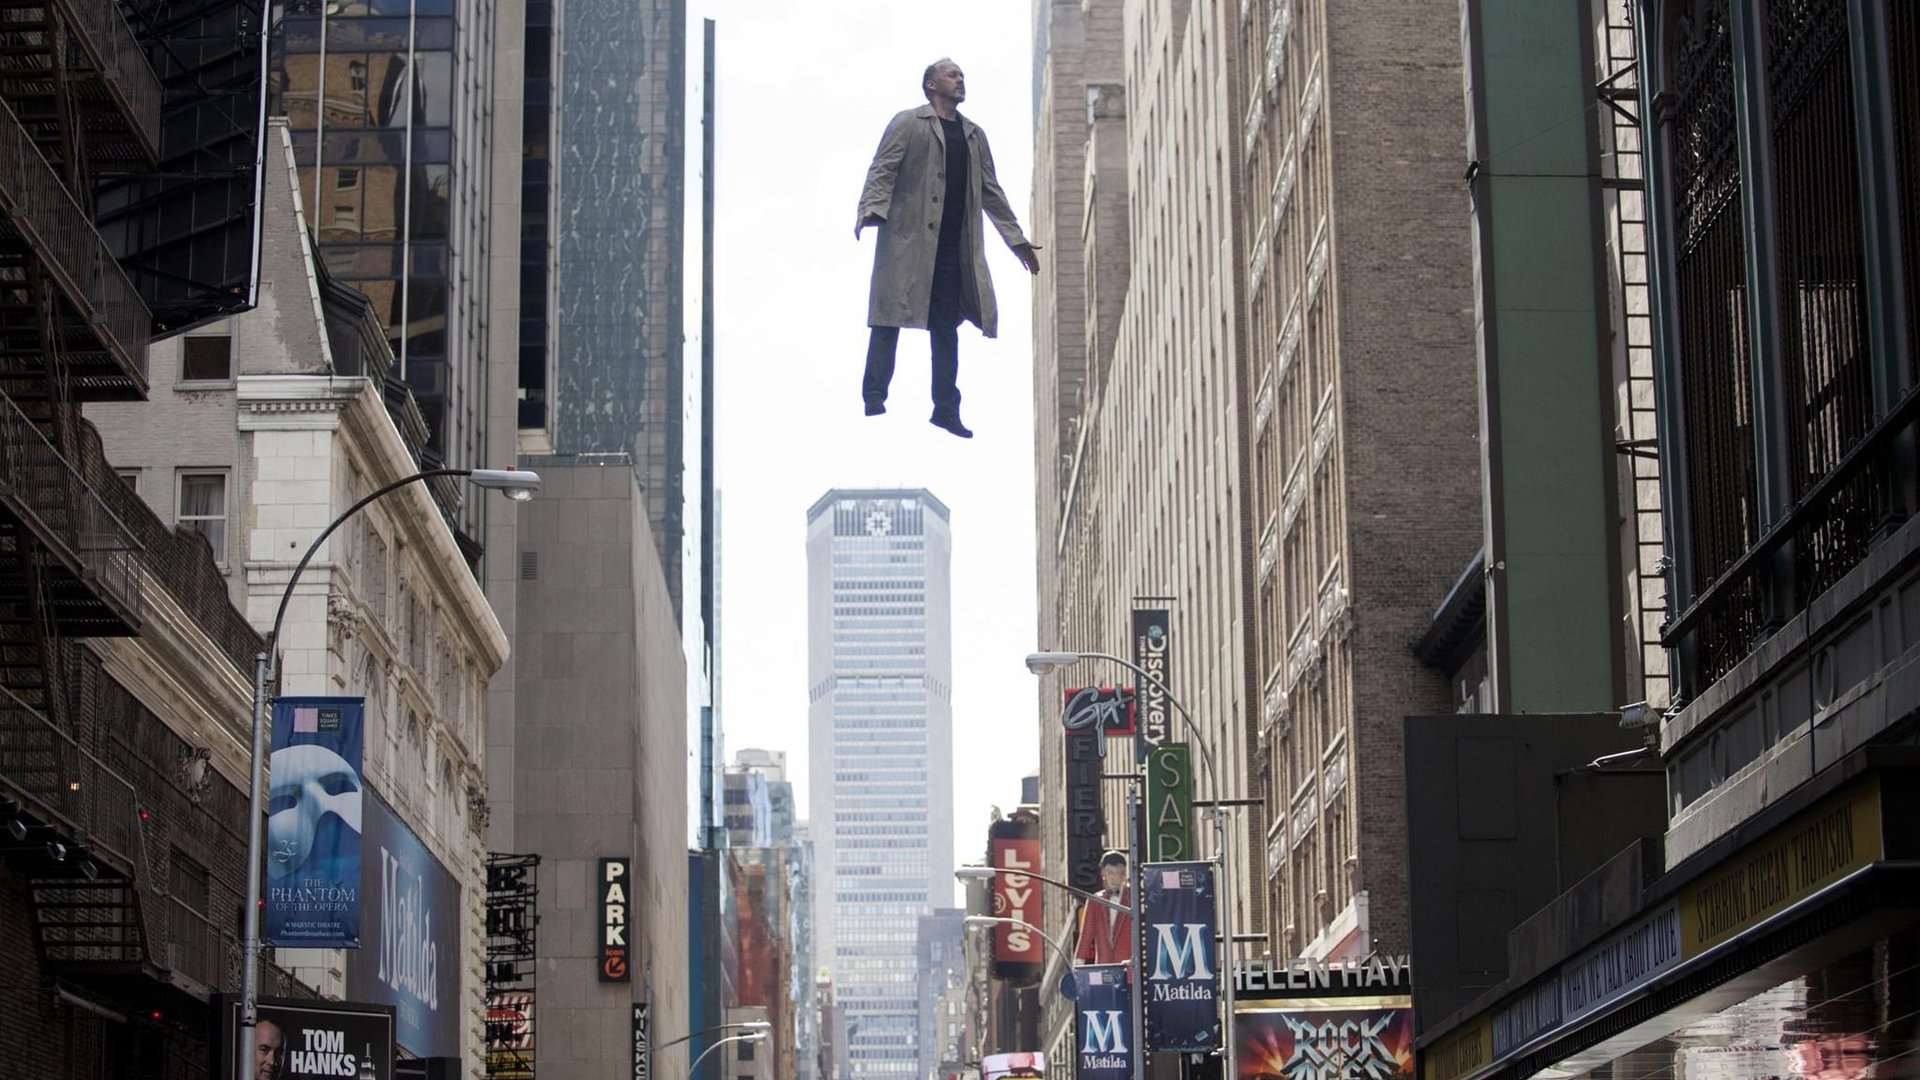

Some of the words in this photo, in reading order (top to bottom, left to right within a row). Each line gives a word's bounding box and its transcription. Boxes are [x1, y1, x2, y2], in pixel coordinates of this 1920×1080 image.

[304, 879, 323, 887] THE
[1697, 870, 1747, 943] STARRING
[1748, 841, 1789, 917] RIGGAN
[1791, 804, 1854, 891] THOMSON
[271, 888, 355, 902] PHANTOM
[275, 903, 290, 912] OF
[292, 903, 311, 912] THE
[314, 903, 348, 912] OPERA
[606, 862, 625, 945] PARK
[378, 846, 437, 1011] Matilda
[1150, 924, 1214, 980] M
[1602, 942, 1622, 994] TALK
[1624, 923, 1650, 984] ABOUT
[1653, 907, 1676, 967] LOVE
[1153, 983, 1212, 1001] Matilda
[303, 1029, 344, 1053] TOM
[1080, 1010, 1128, 1053] M
[1281, 1010, 1400, 1072] ROCK
[291, 1051, 356, 1077] HANKS
[1083, 1055, 1126, 1069] Matilda
